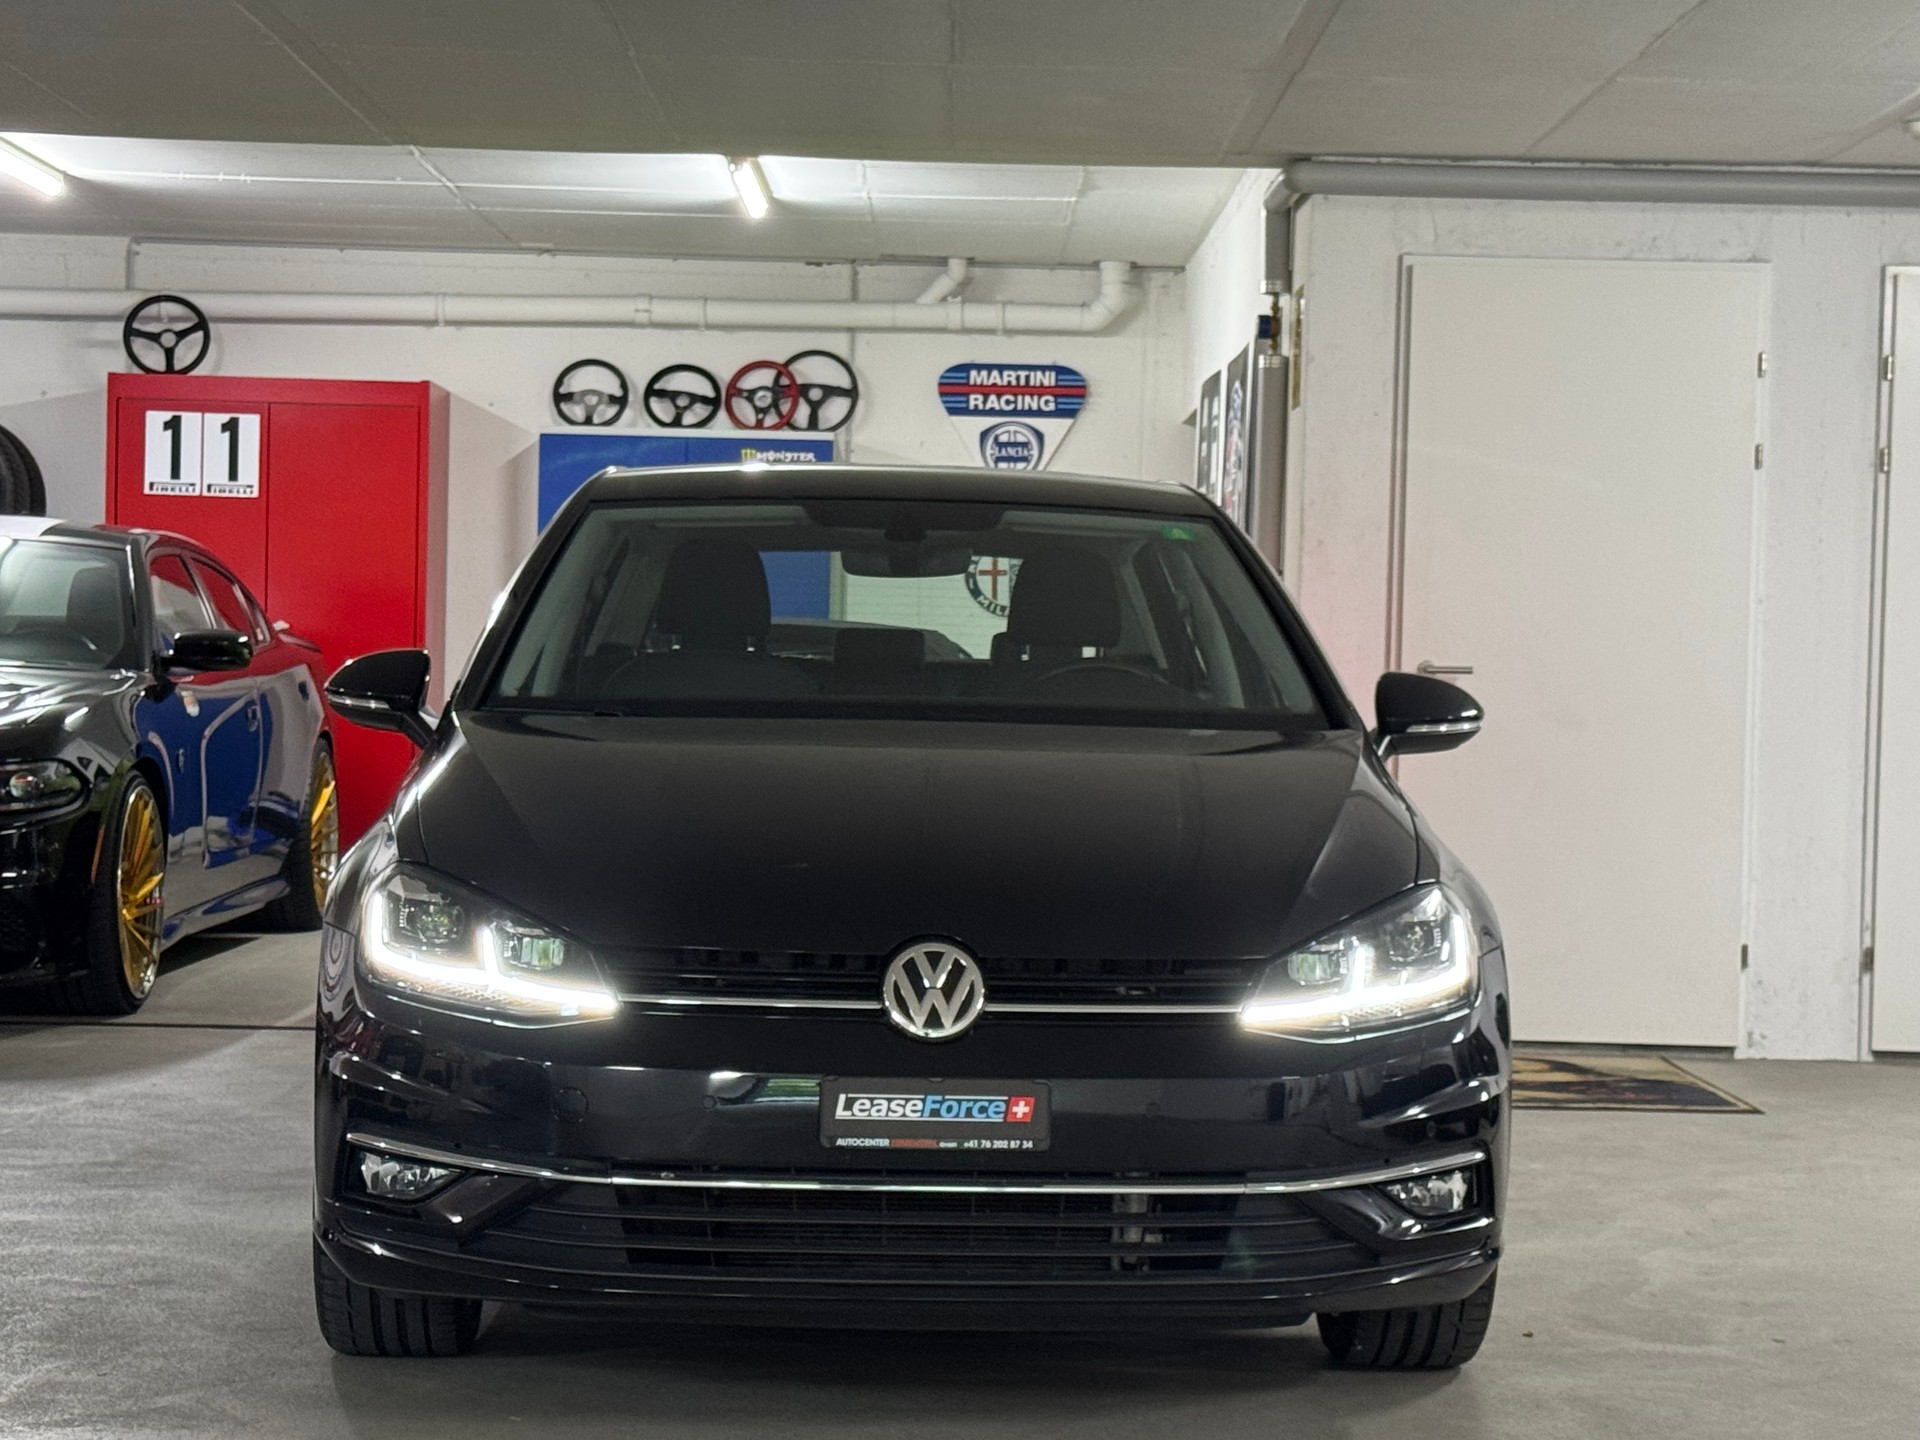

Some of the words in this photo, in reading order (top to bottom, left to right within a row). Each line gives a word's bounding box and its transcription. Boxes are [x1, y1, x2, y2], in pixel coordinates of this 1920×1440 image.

[968, 369, 1057, 387] MARTINI
[968, 394, 1057, 412] RACING
[994, 446, 1030, 457] LANCIA
[834, 1092, 1007, 1121] LeaseForce
[836, 1138, 891, 1147] AUTOCENTER
[980, 1140, 992, 1149] 76
[992, 1140, 1009, 1149] 202
[1022, 1140, 1034, 1149] 34
